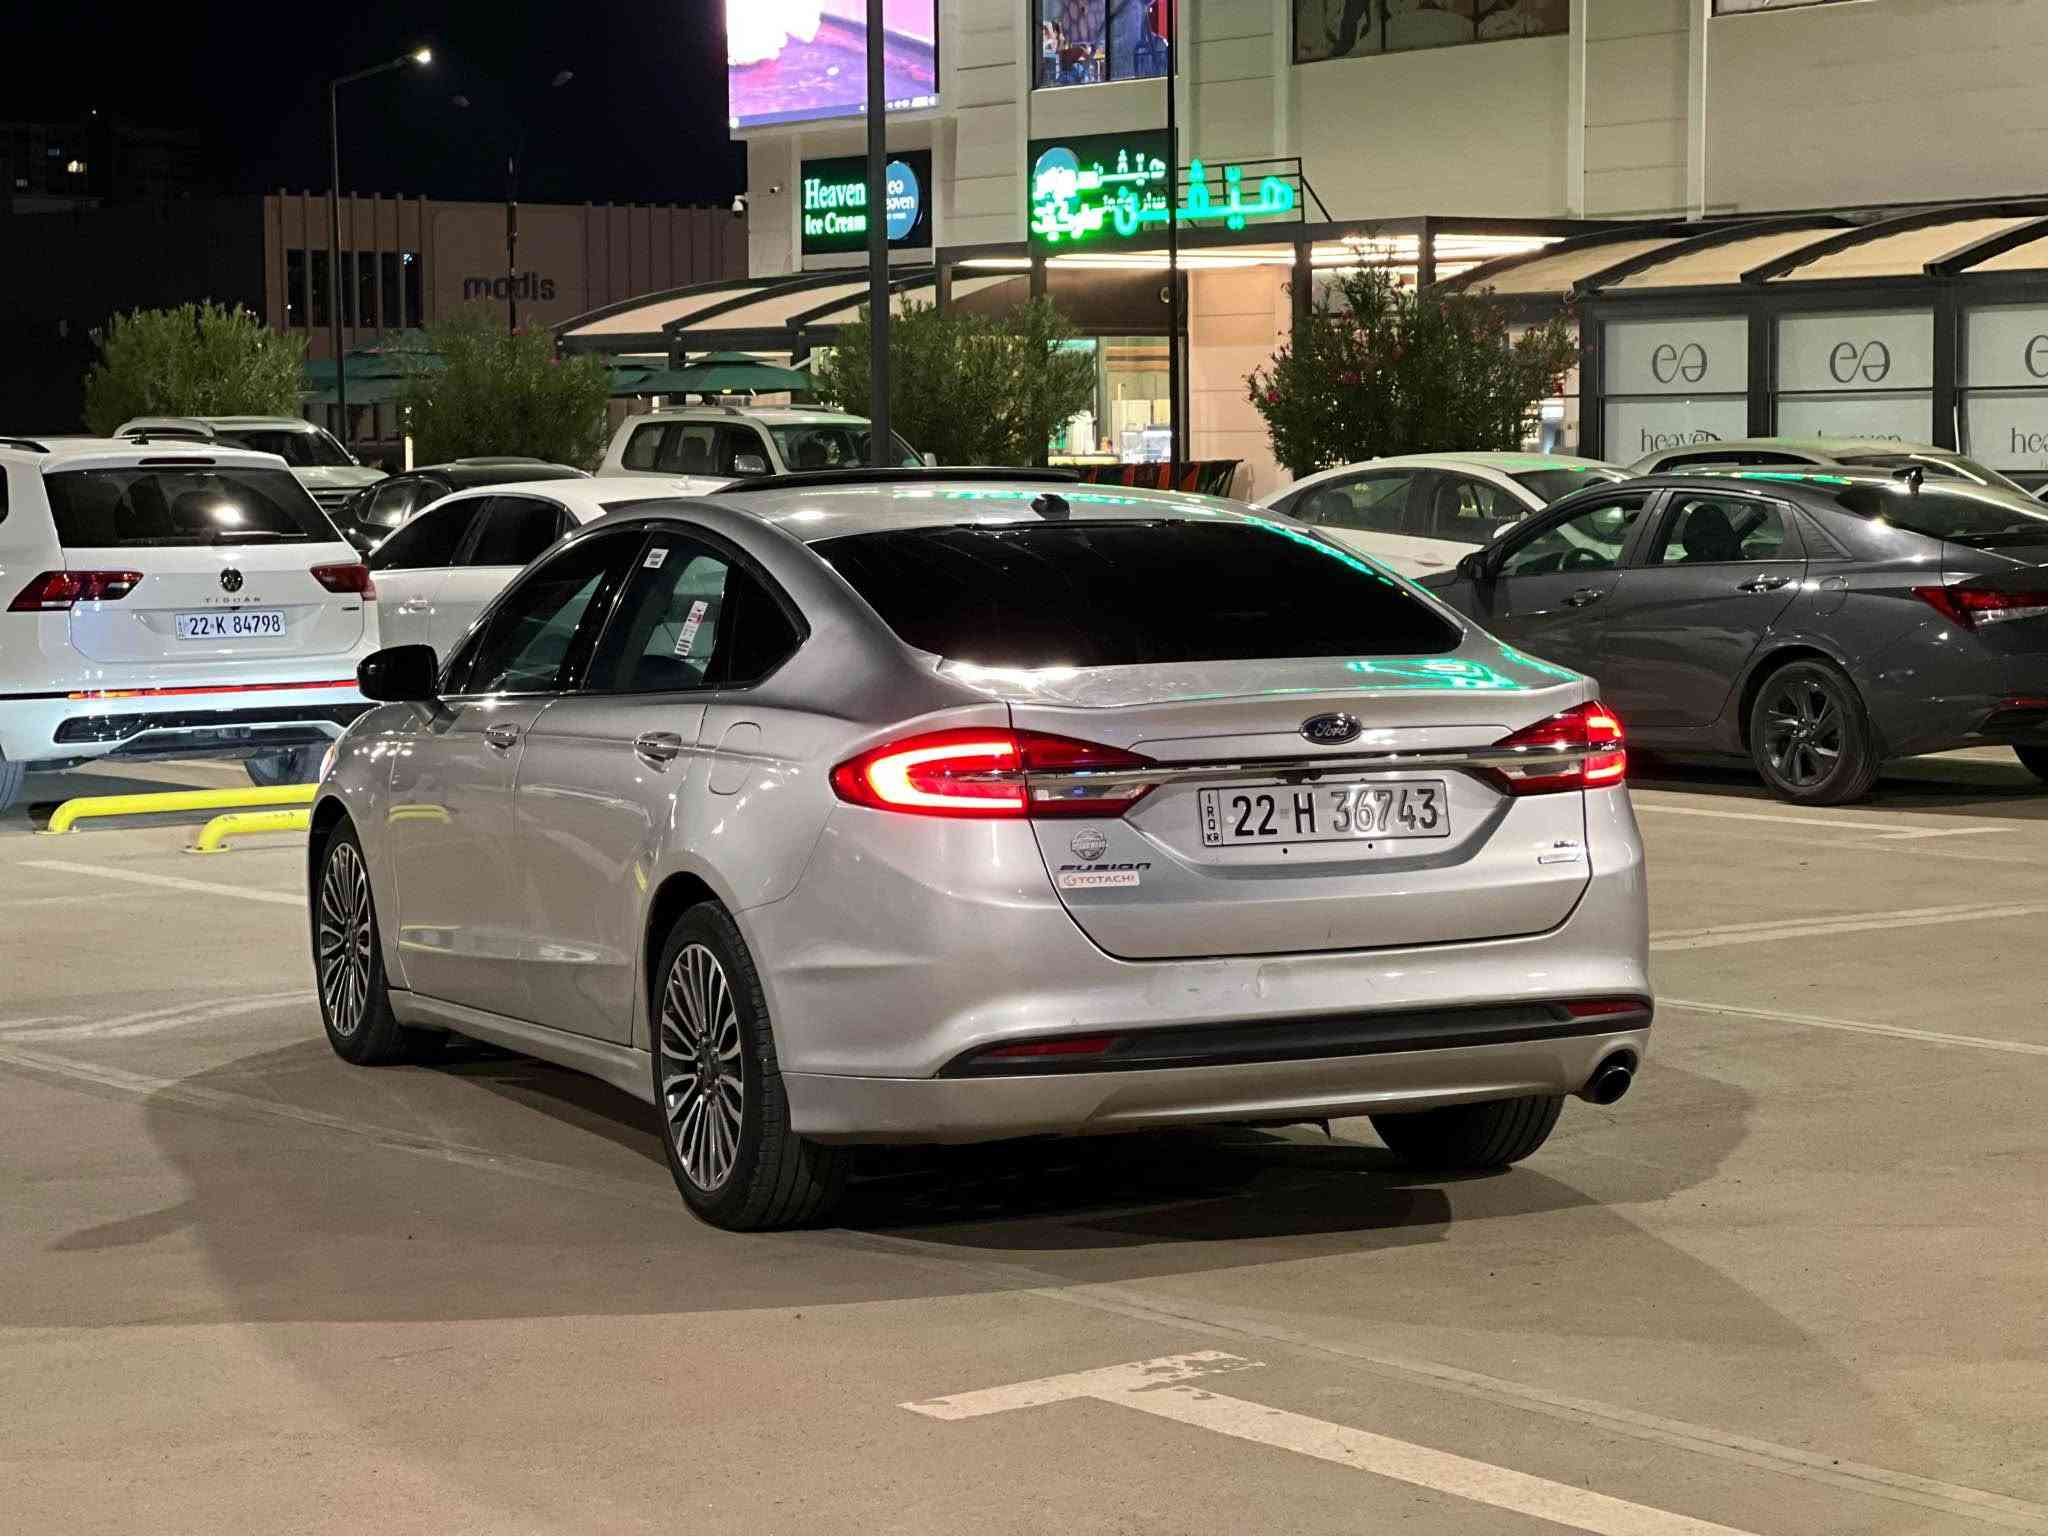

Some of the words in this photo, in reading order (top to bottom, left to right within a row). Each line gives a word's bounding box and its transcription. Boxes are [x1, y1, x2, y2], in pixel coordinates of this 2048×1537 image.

[804, 178, 867, 210] Heaven
[805, 214, 823, 235] Ice
[825, 211, 866, 234] Cream
[189, 617, 210, 636] 22
[216, 616, 227, 635] K
[233, 614, 281, 634] 84798
[1314, 719, 1350, 737] Ford
[1231, 794, 1278, 837] 22
[1293, 791, 1317, 834] H
[1329, 788, 1438, 833] 36743
[1206, 832, 1219, 842] KR
[1060, 862, 1152, 872] FUSION
[1077, 874, 1136, 886] TOTACHI
